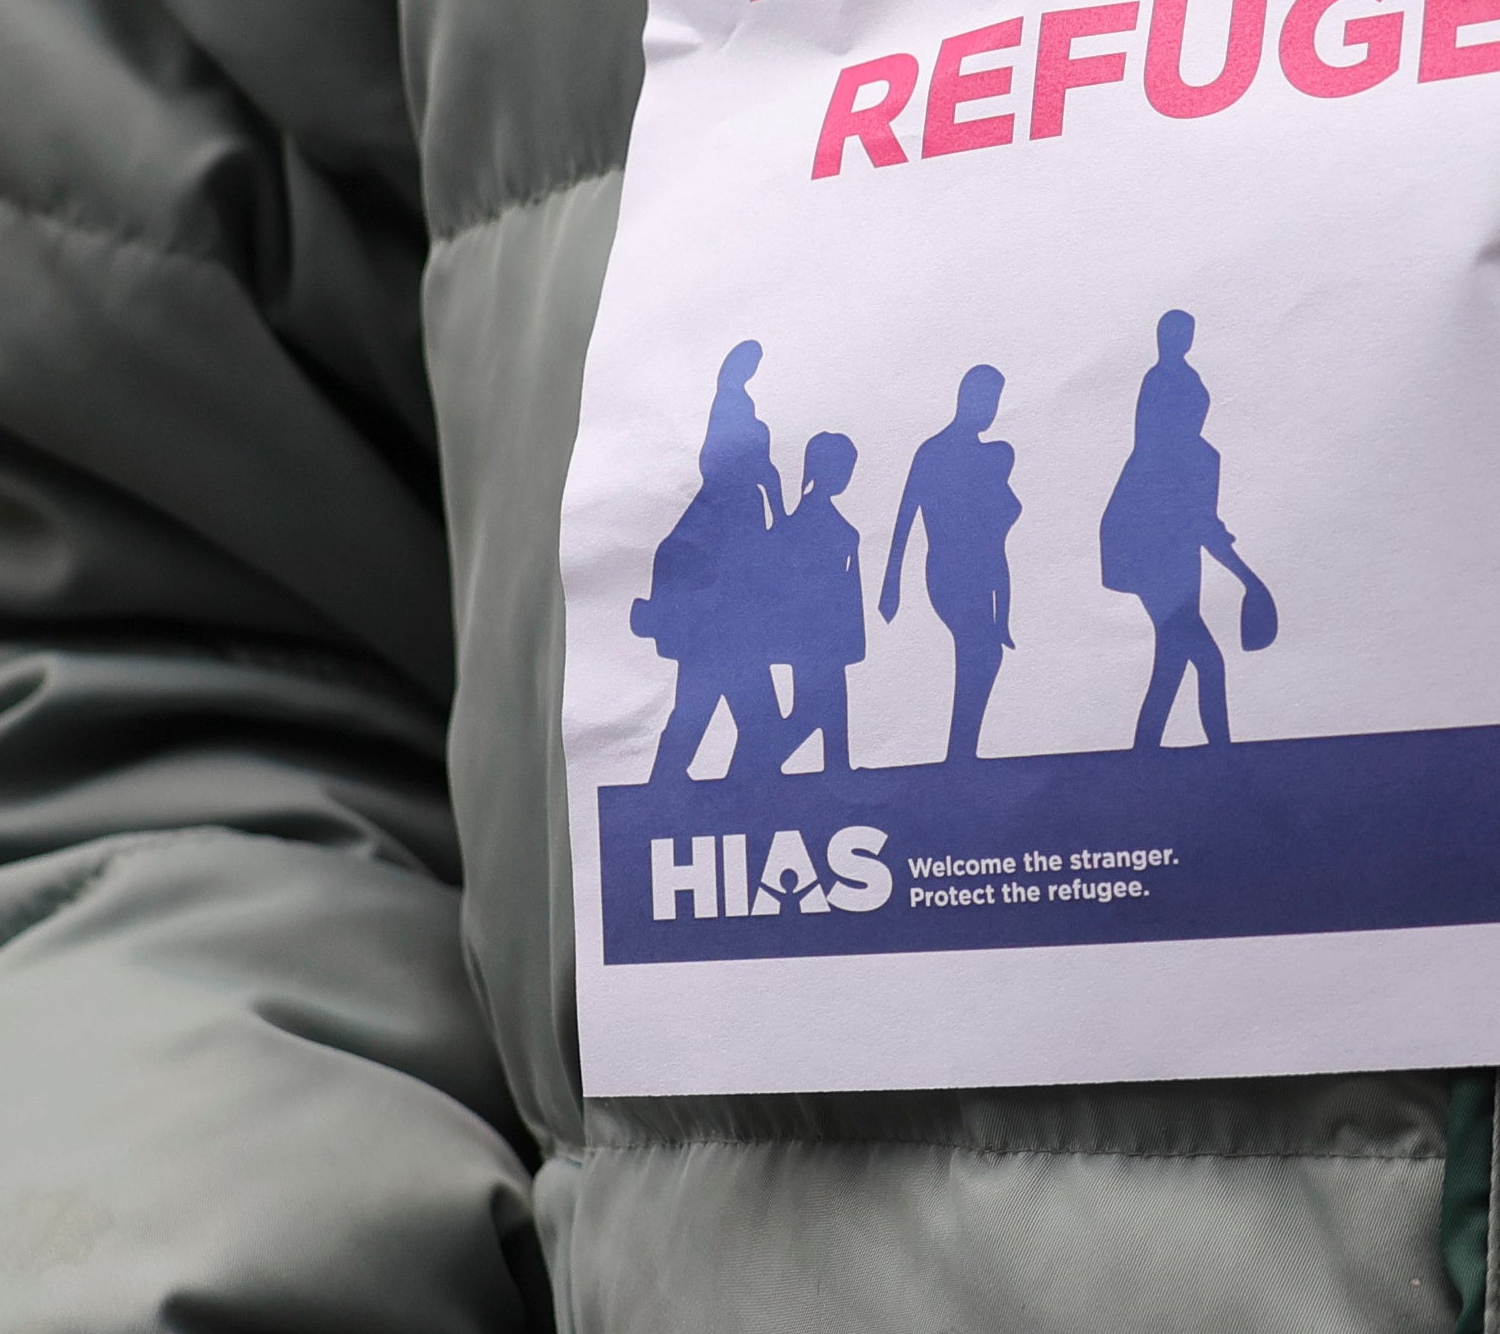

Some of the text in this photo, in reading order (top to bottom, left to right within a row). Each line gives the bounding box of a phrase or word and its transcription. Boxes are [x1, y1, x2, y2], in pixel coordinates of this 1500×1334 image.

[650, 825, 894, 921] HIAS
[907, 845, 1180, 879] Welcome the stranger.
[909, 877, 1151, 908] Protect the refugee.
